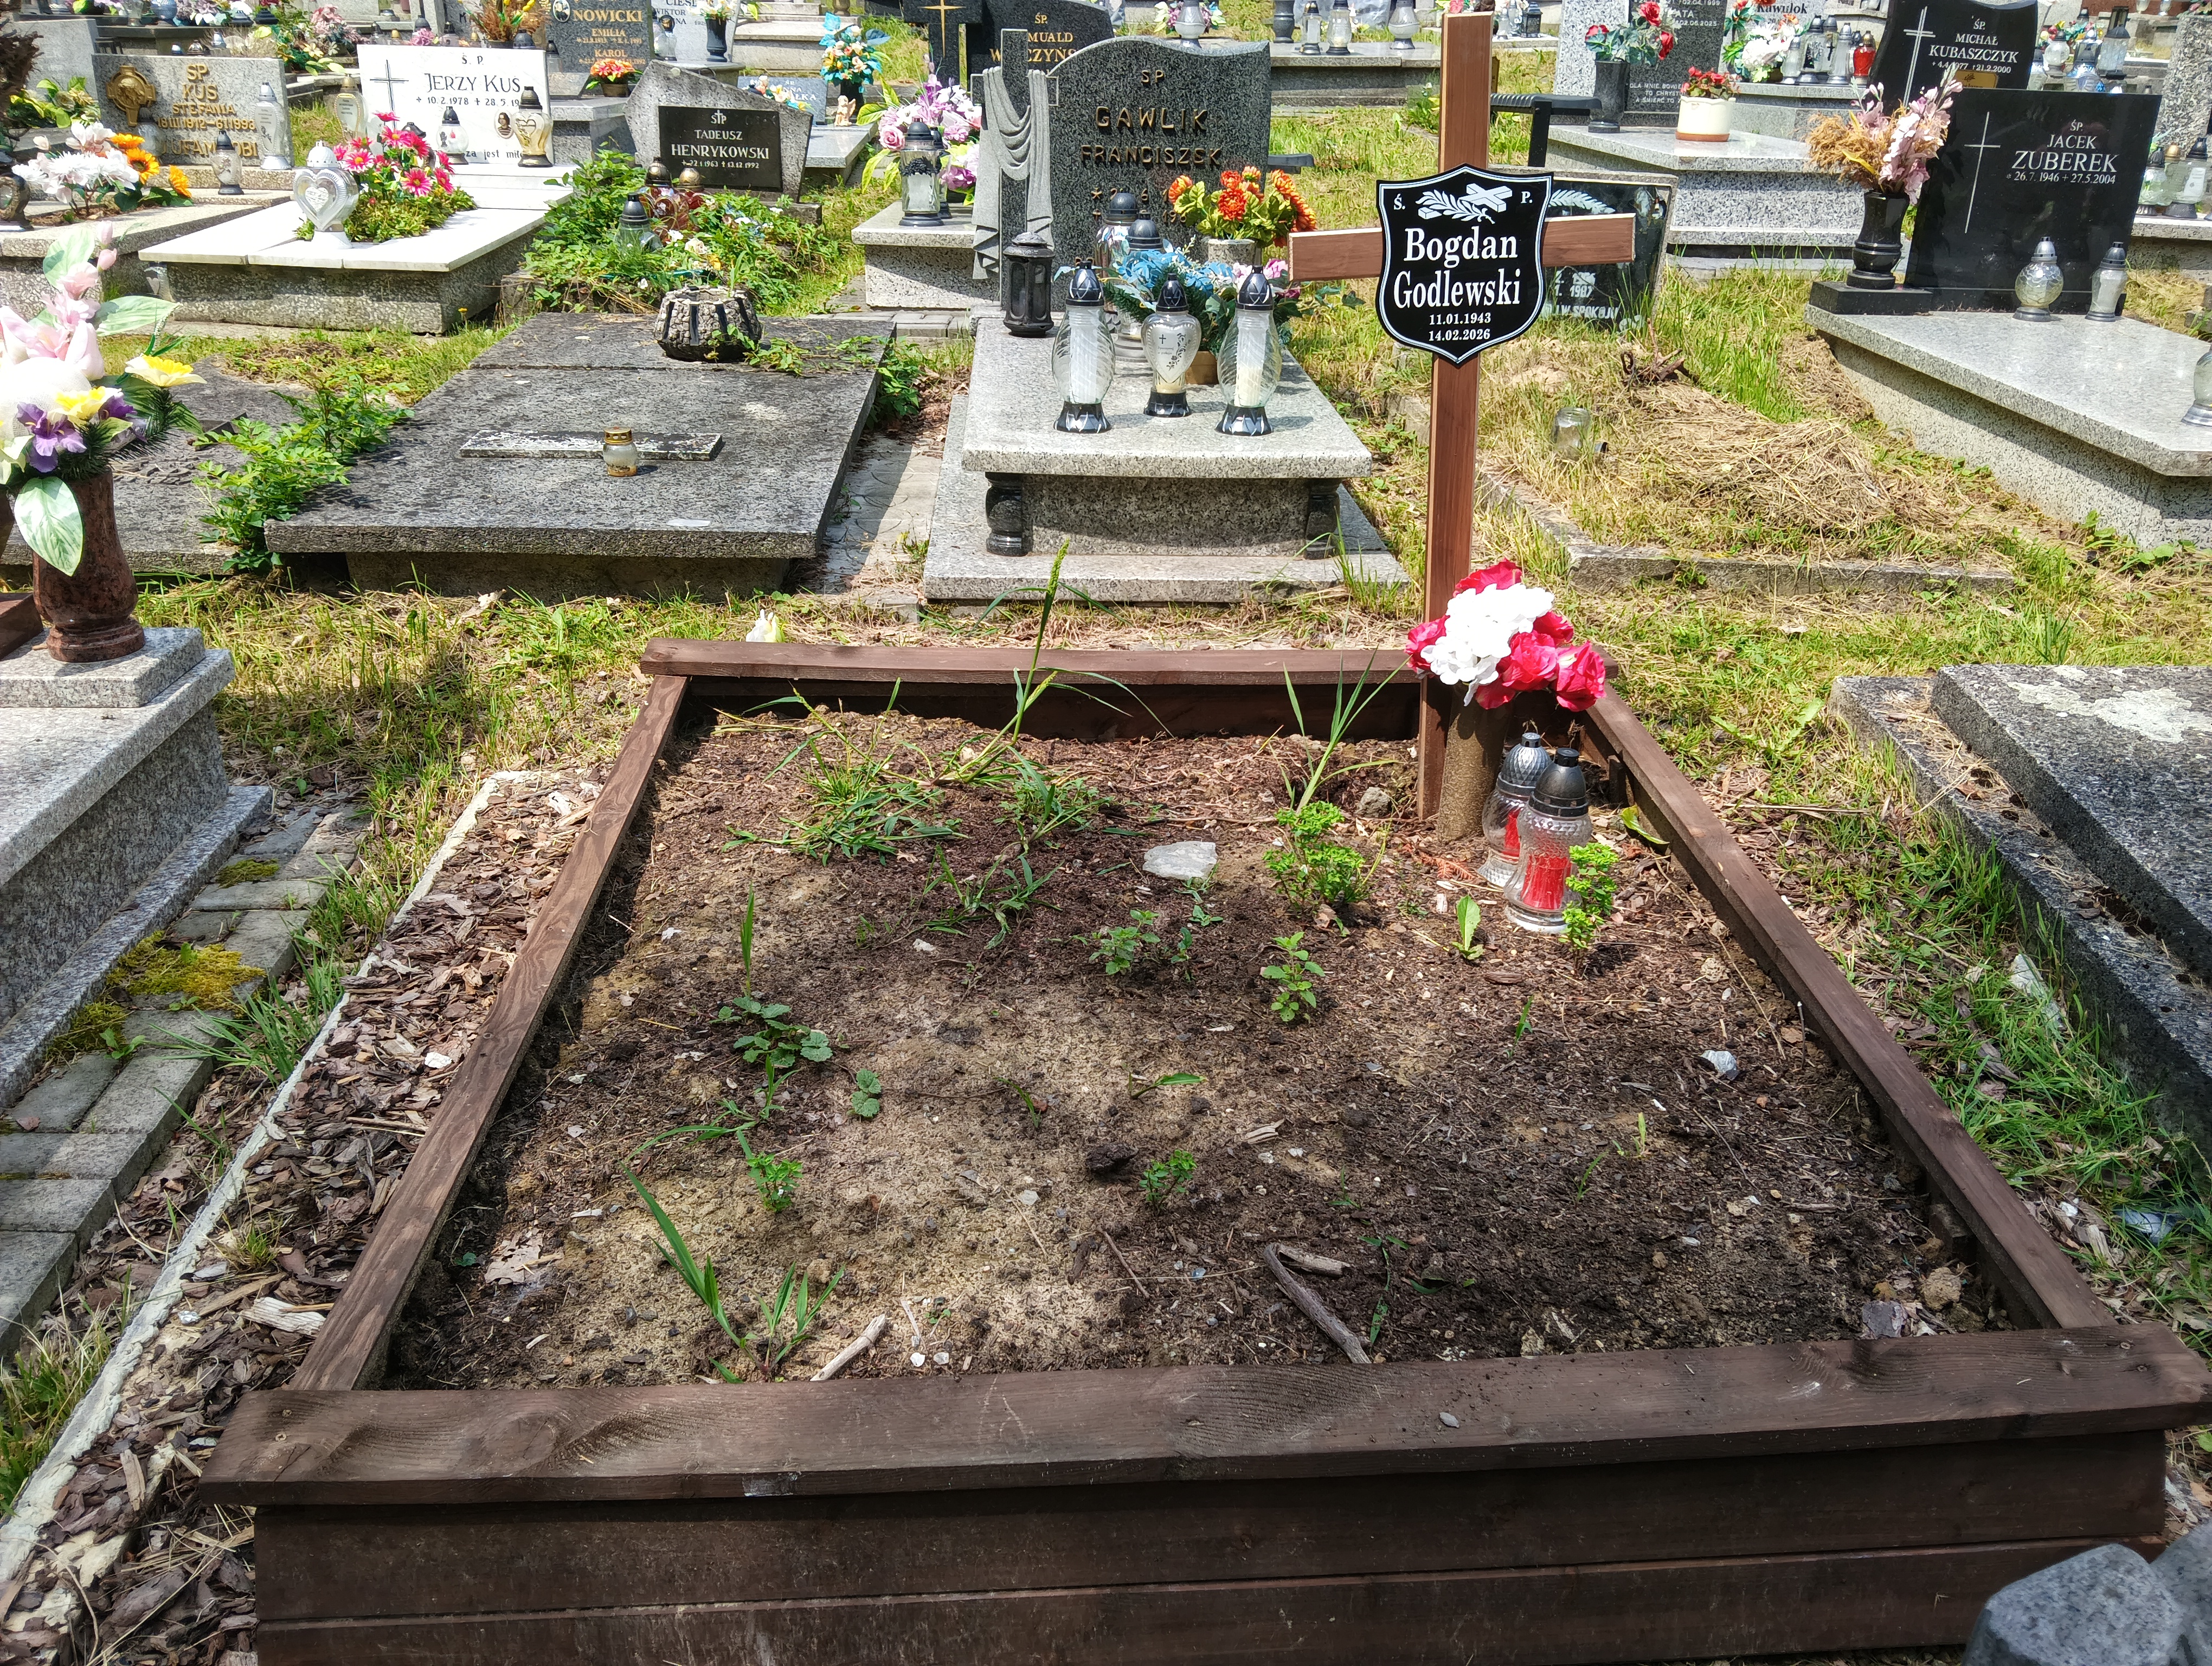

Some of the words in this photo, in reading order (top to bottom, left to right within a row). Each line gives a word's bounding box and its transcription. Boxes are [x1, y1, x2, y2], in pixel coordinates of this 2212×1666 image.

[573, 10, 643, 22] NOWICKI
[591, 28, 627, 36] EMILIA
[1027, 32, 1073, 43] MUALD
[1955, 33, 1999, 46] MICHAŁ
[1928, 44, 2019, 63] KUBASZCZYK
[1976, 64, 2011, 73] 21.2.2000
[424, 73, 477, 92] JERZY
[172, 102, 236, 114] STEFANIA
[485, 98, 520, 107] 28.5.19
[1096, 106, 1208, 130] GAWLIK
[694, 130, 743, 140] TADEUSZ
[2047, 134, 2098, 149] JACEK
[171, 139, 216, 156] UFAM
[671, 144, 769, 159] HENRYKOWSKI
[484, 149, 499, 160] jest
[1081, 145, 1221, 165] FRANCISZEK
[2011, 150, 2120, 172] ZUBEREK
[2070, 173, 2116, 184] 27.5.2004
[1393, 194, 1406, 210] Ś.
[1520, 191, 1533, 203] P.
[1403, 226, 1518, 268] Bogdan
[1393, 268, 1521, 309] Godlewski
[1429, 312, 1491, 325] 11.01.1943
[1428, 329, 1491, 342] 14.02.2026
